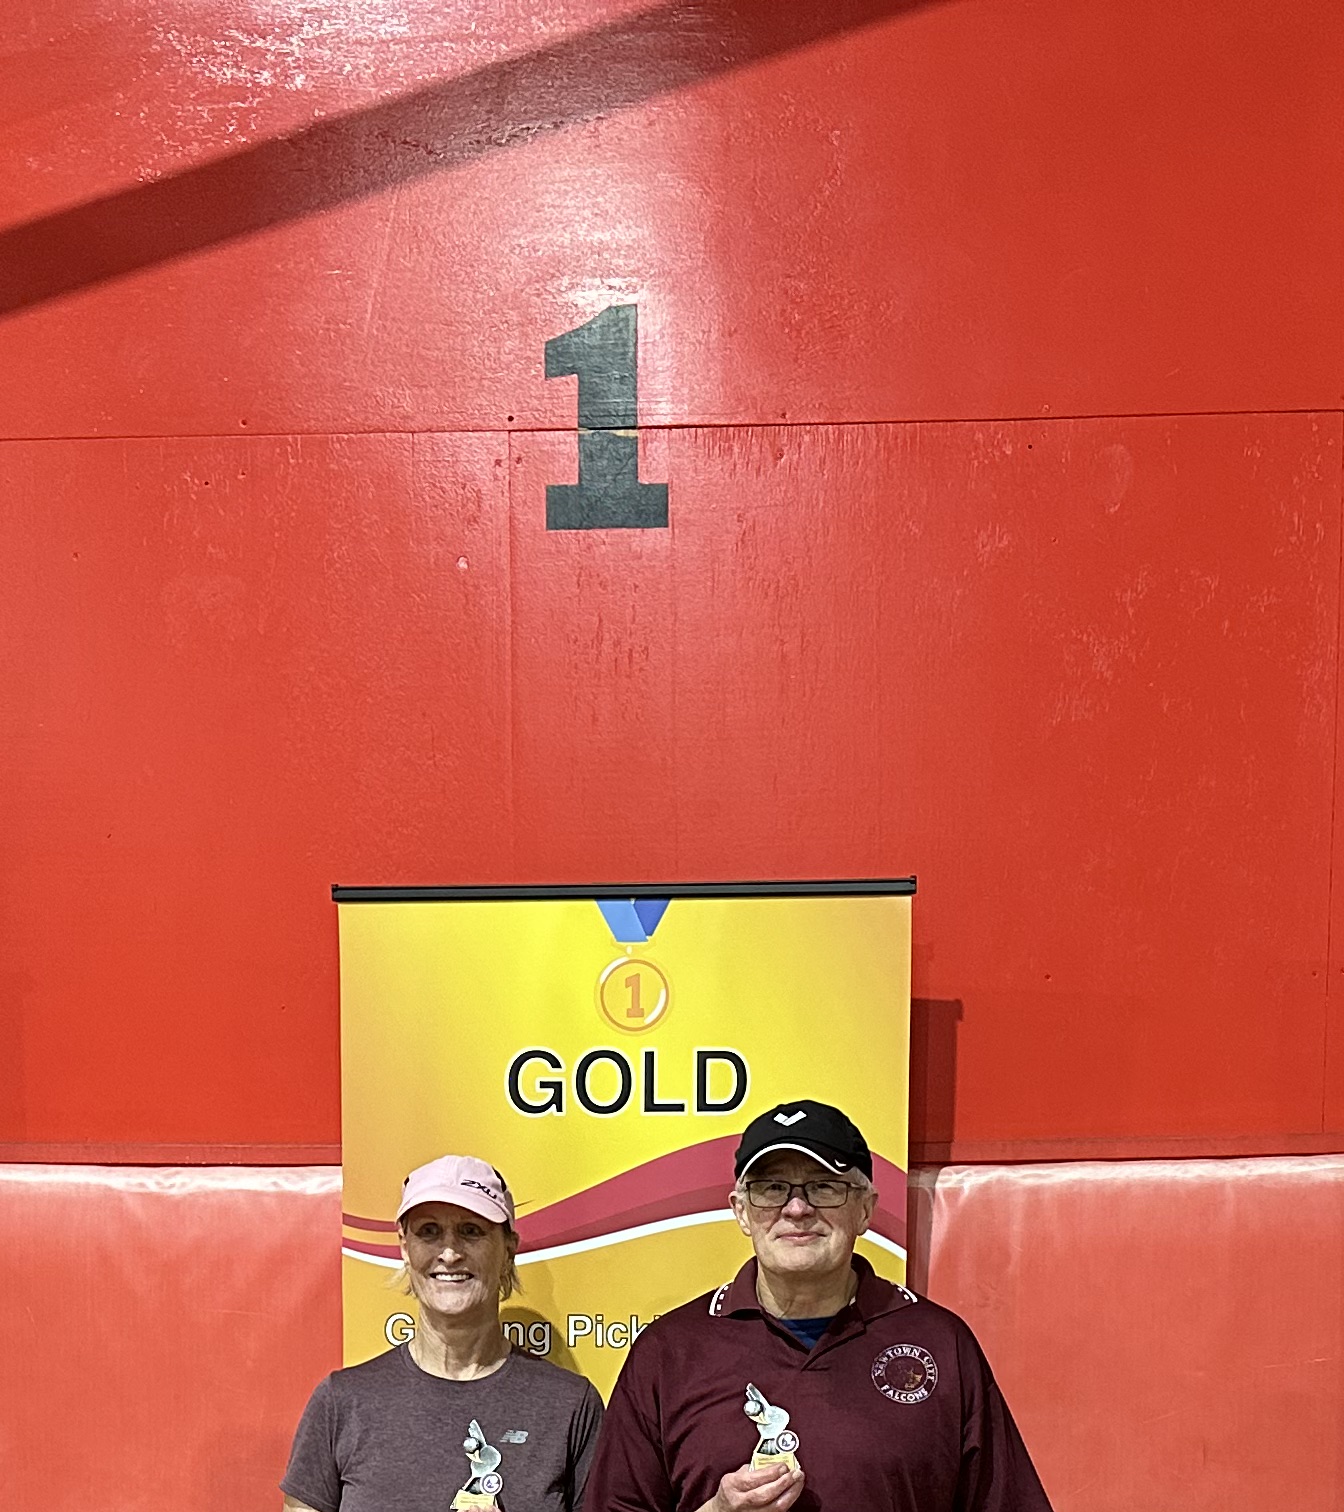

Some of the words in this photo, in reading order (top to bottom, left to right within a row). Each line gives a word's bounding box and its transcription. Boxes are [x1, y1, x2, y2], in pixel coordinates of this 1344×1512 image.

[545, 303, 669, 530] 1
[623, 973, 645, 1018] 1
[507, 1049, 749, 1114] GOLD
[880, 1384, 929, 1402] FALCONS
